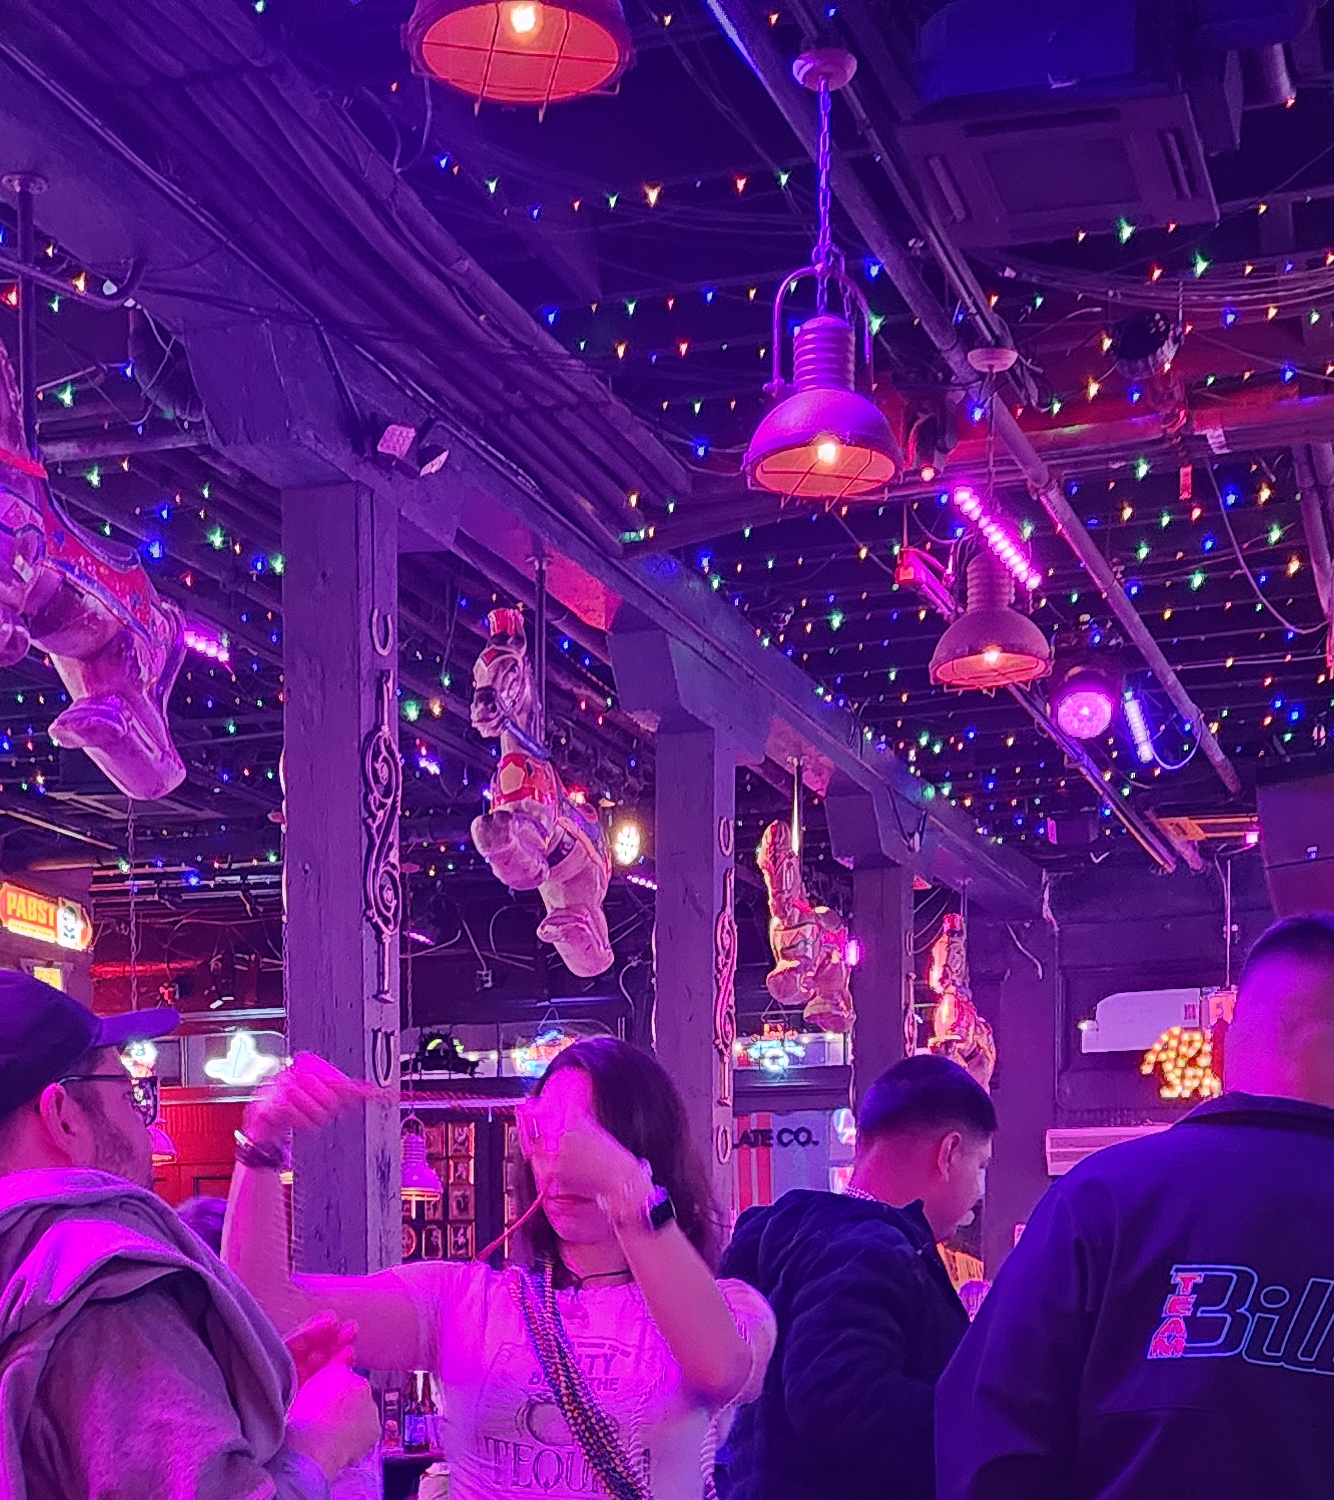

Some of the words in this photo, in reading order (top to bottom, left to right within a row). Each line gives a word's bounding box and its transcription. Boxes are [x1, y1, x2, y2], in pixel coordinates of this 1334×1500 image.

[6, 890, 56, 928] PABST
[776, 1126, 820, 1148] CO.
[1149, 1273, 1205, 1358] TEAM
